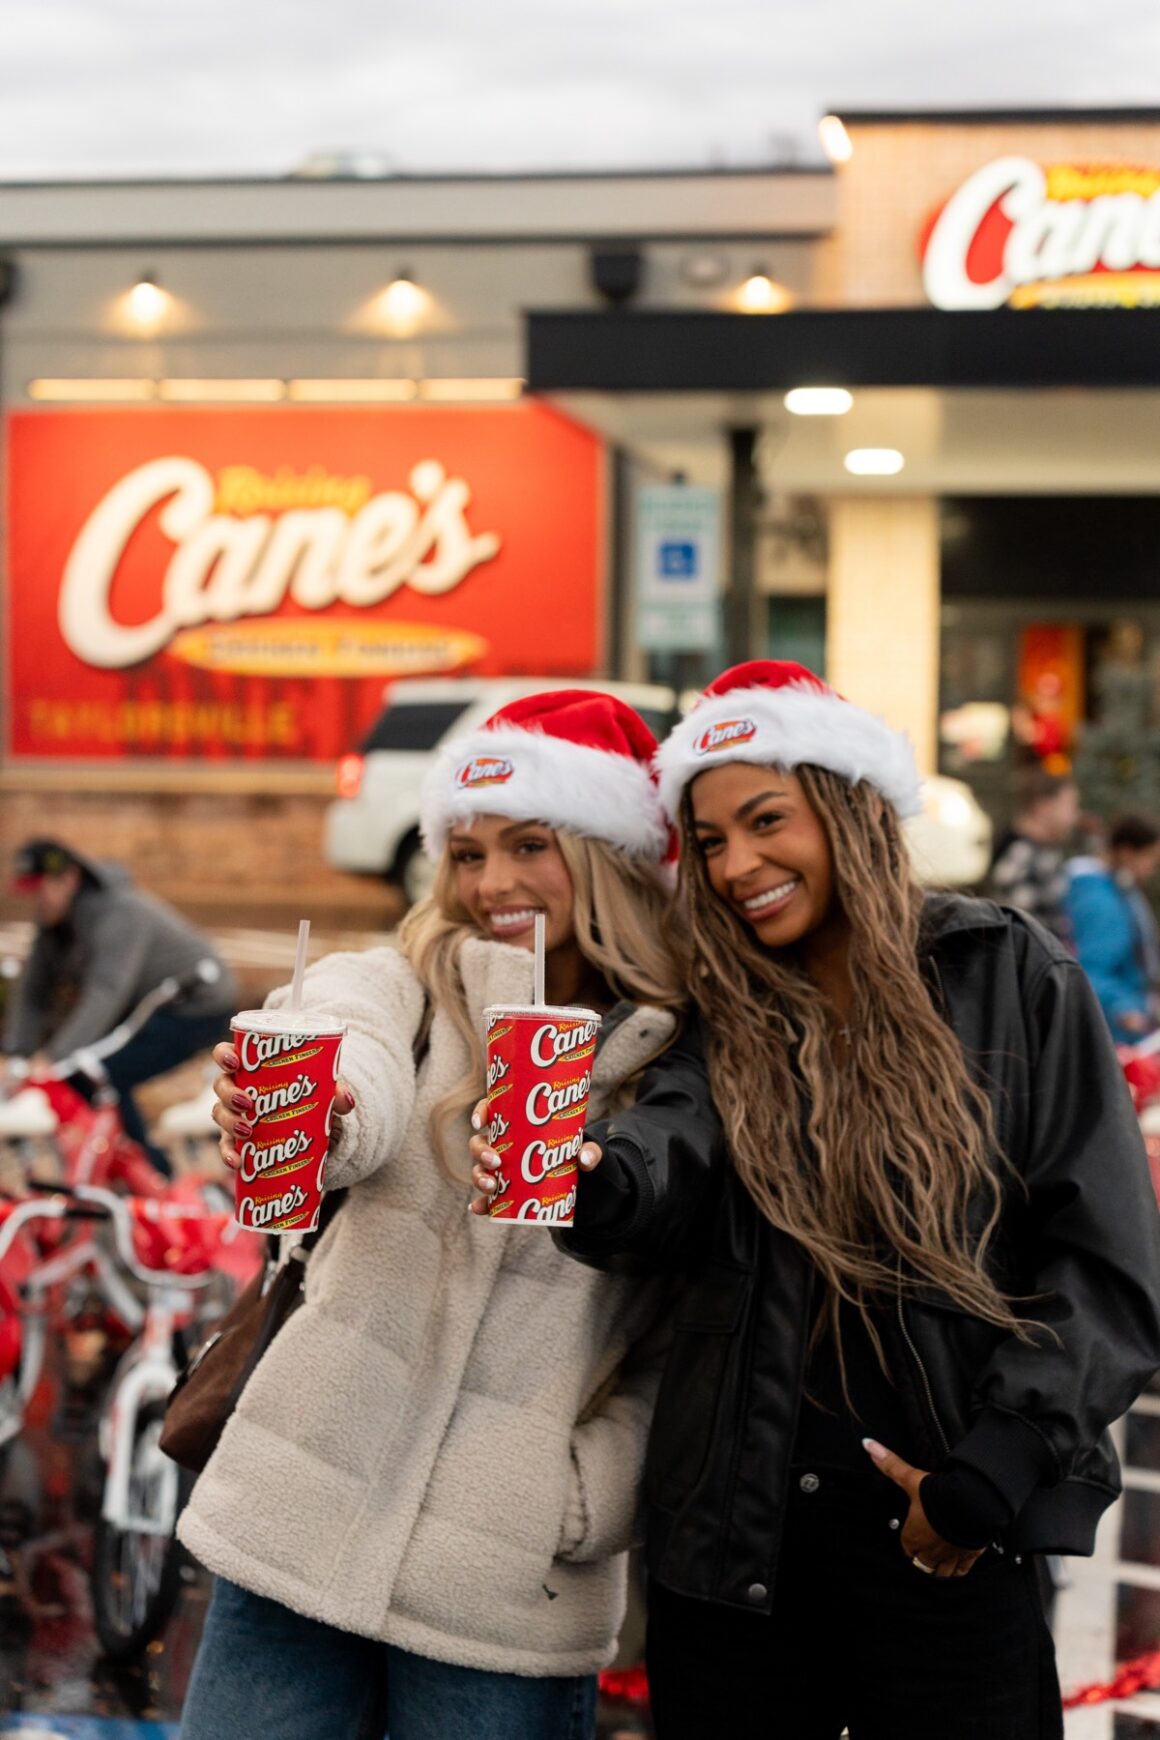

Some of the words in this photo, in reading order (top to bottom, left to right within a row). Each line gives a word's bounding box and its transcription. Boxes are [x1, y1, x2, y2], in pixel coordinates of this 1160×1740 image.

[923, 156, 1160, 310] Can
[58, 456, 501, 668] Cane's
[692, 717, 756, 756] Cane's
[455, 756, 514, 790] Cane's
[269, 1056, 294, 1067] CHICKEN
[294, 1047, 321, 1060] FINGERS
[258, 1081, 289, 1093] Raising
[526, 1069, 590, 1125] Cane's
[241, 1129, 312, 1182] Cane's
[256, 1137, 286, 1150] Raising
[521, 1127, 583, 1183] Cane's
[264, 1167, 287, 1178] CHICKEN
[288, 1158, 311, 1171] FINGERS
[240, 1184, 308, 1227] Cane's
[255, 1192, 283, 1205] Raising
